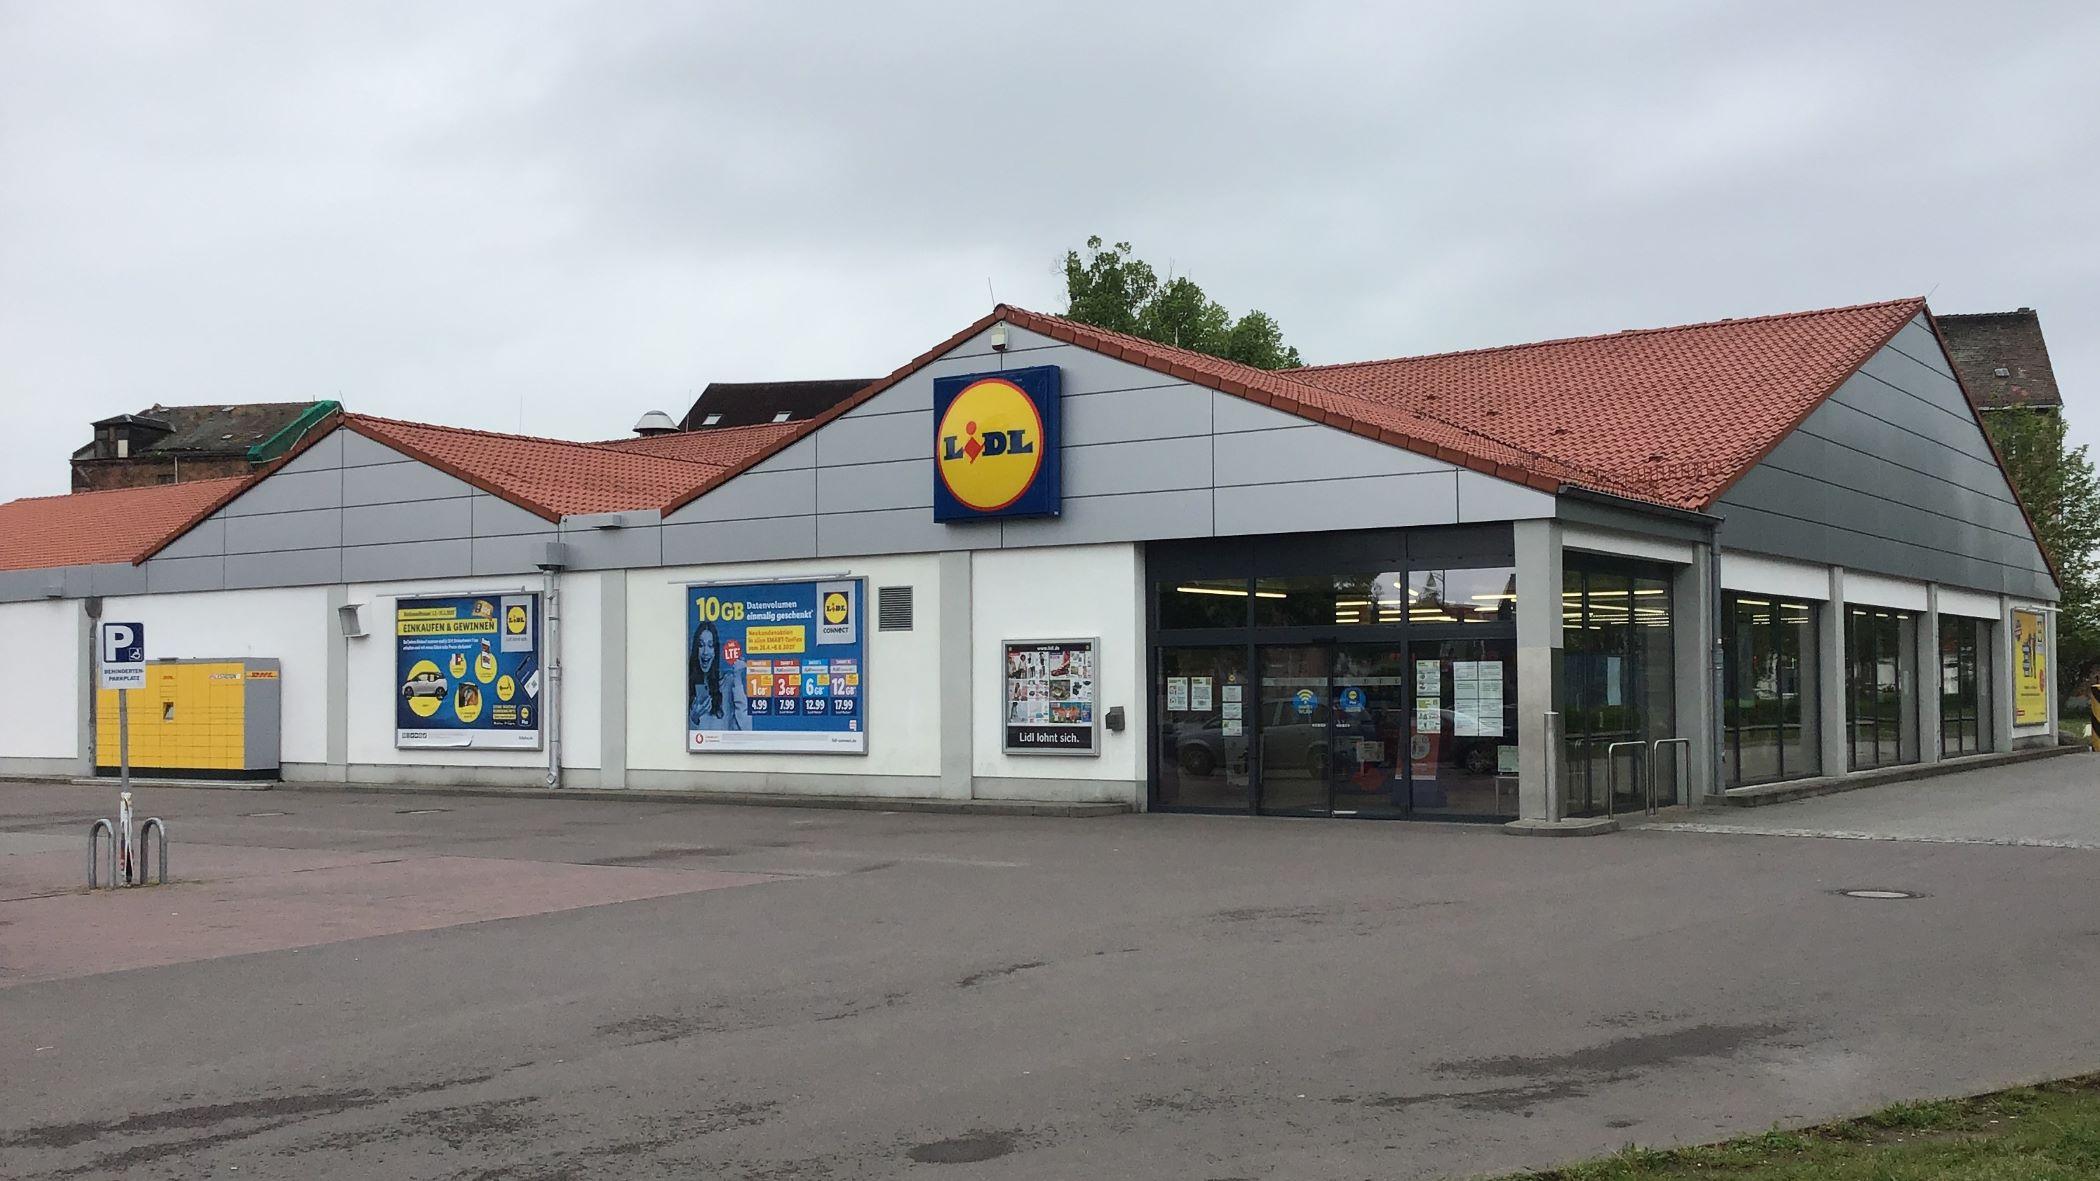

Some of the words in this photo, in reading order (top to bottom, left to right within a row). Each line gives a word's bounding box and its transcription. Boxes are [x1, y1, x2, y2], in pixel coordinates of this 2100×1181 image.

[746, 601, 797, 610] Datenvolumen
[746, 611, 776, 622] einmalig
[403, 623, 445, 633] EINKAUFEN
[453, 620, 495, 632] GEWINNEN
[105, 625, 134, 661] P
[751, 699, 768, 710] 4.99
[779, 699, 795, 710] 7.99
[805, 699, 825, 710] 12.99
[834, 699, 854, 710] 17.99
[1020, 732, 1035, 742] Lidl
[1036, 732, 1058, 743] lohnt
[1060, 732, 1080, 743] sich.
